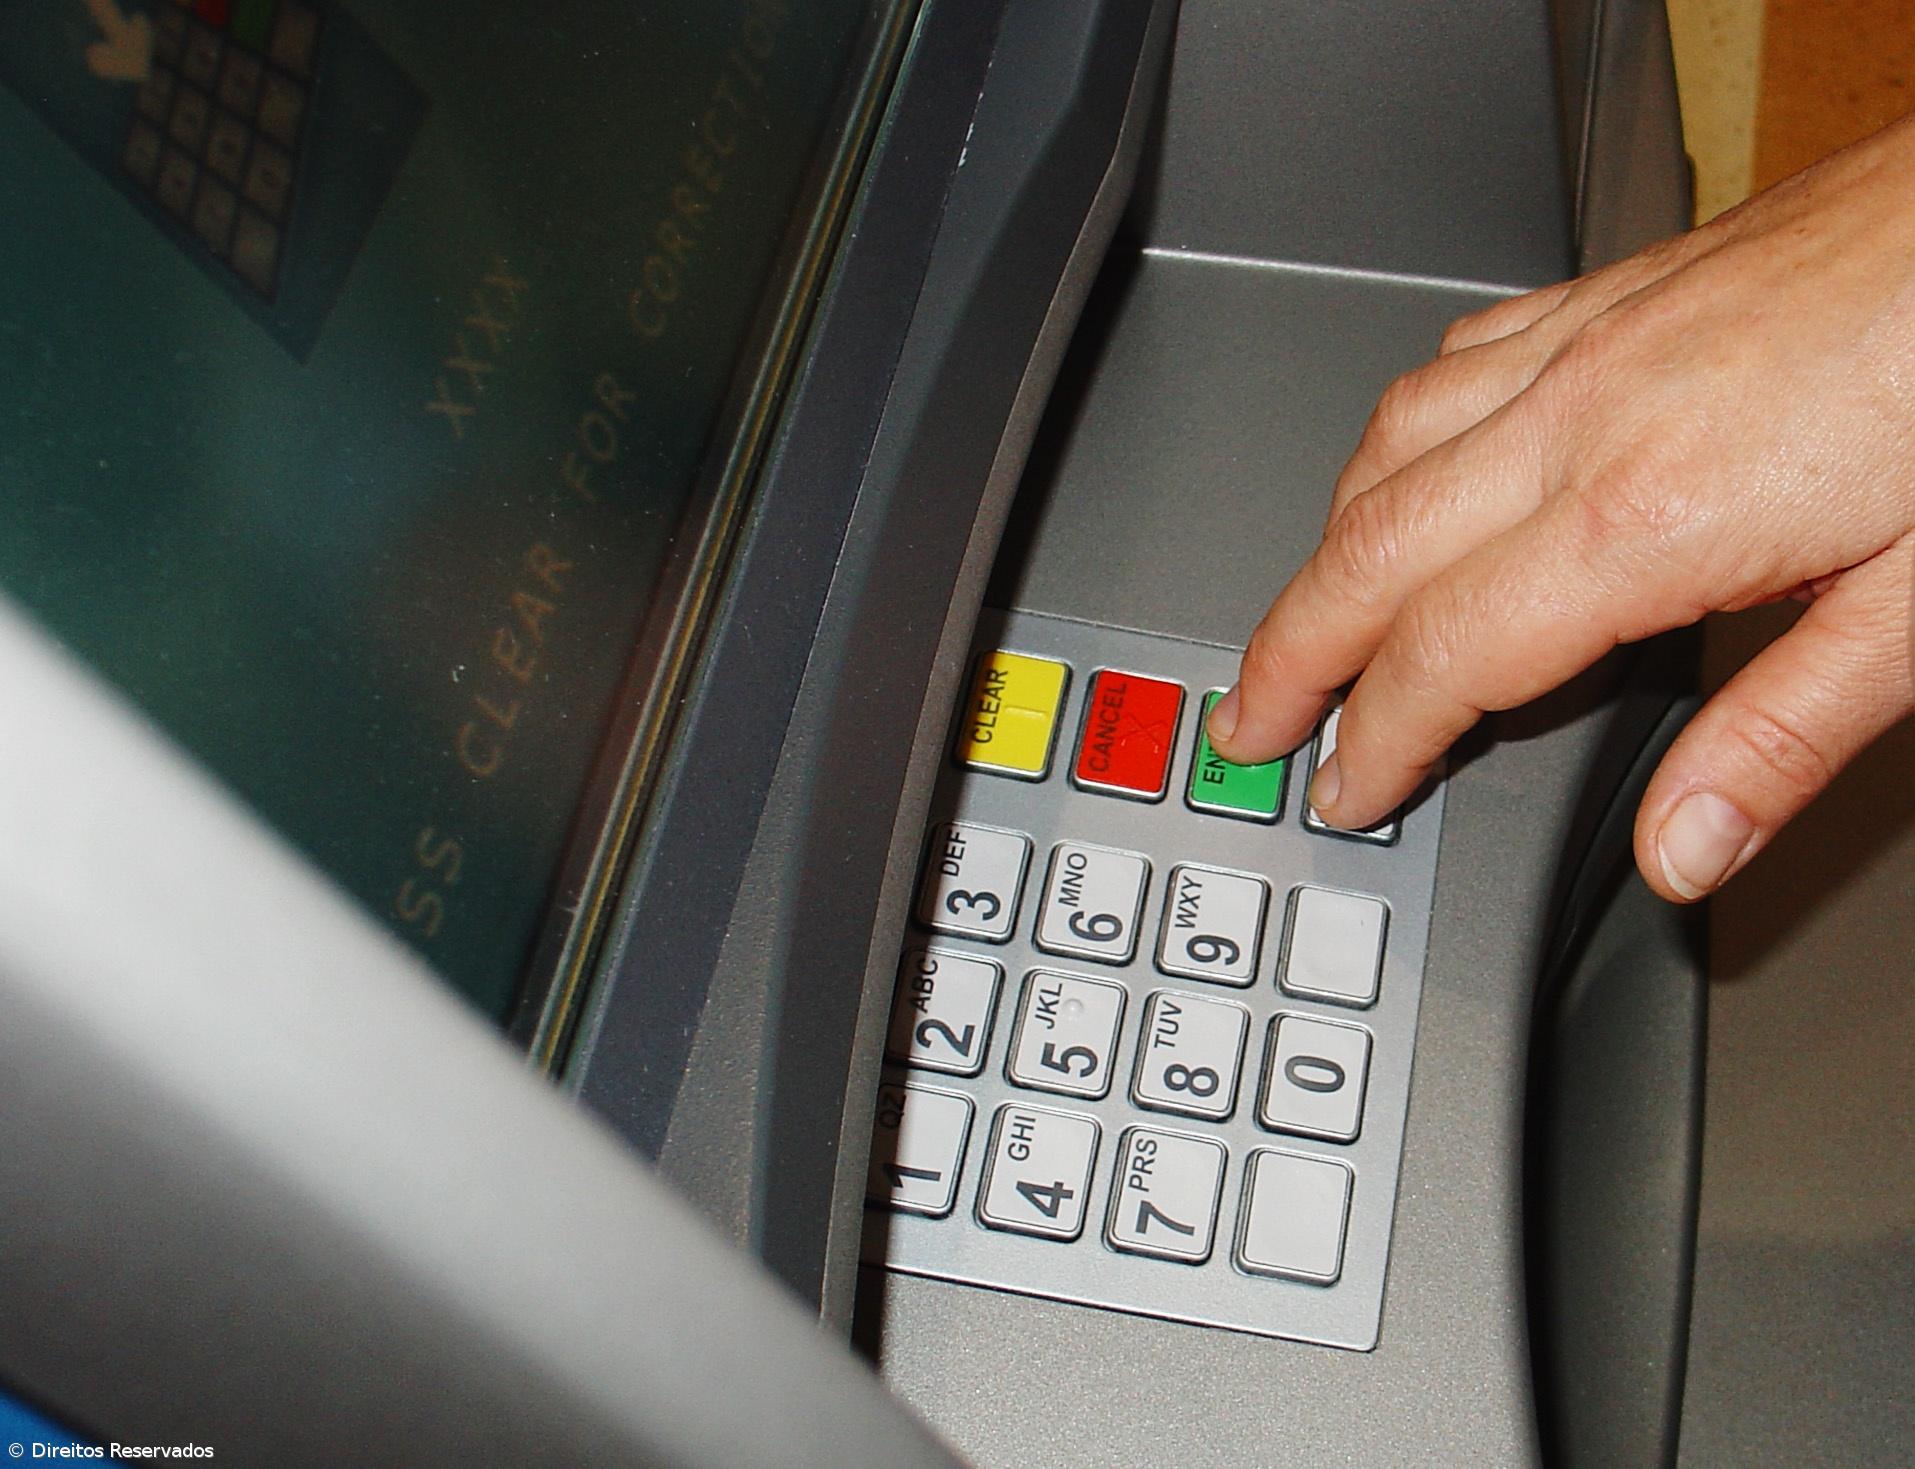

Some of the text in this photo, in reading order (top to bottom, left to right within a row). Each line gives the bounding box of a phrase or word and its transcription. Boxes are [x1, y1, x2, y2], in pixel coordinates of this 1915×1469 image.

[456, 544, 574, 777] CLEAR
[564, 374, 636, 502] FOR
[971, 667, 1008, 744] CLEAR
[1088, 682, 1128, 773] CANCEL
[1203, 747, 1226, 785] EN
[941, 828, 966, 877] DEF
[1057, 852, 1088, 907] MNO
[945, 888, 1001, 921] 3
[1173, 875, 1203, 929] WXY
[1068, 909, 1123, 943] 6
[1185, 934, 1240, 967] 9
[909, 957, 940, 1013] ABC
[1034, 982, 1064, 1031] JKL
[914, 1017, 975, 1057] 2
[1153, 1000, 1183, 1050] TUV
[1040, 1042, 1098, 1079] 5
[1163, 1063, 1220, 1098] 8
[1284, 1054, 1346, 1094] 0
[1007, 1115, 1037, 1162] GHI
[880, 1161, 942, 1189] 1
[1128, 1137, 1158, 1193] PRS
[1015, 1181, 1074, 1219] 4
[1135, 1201, 1196, 1237] 7
